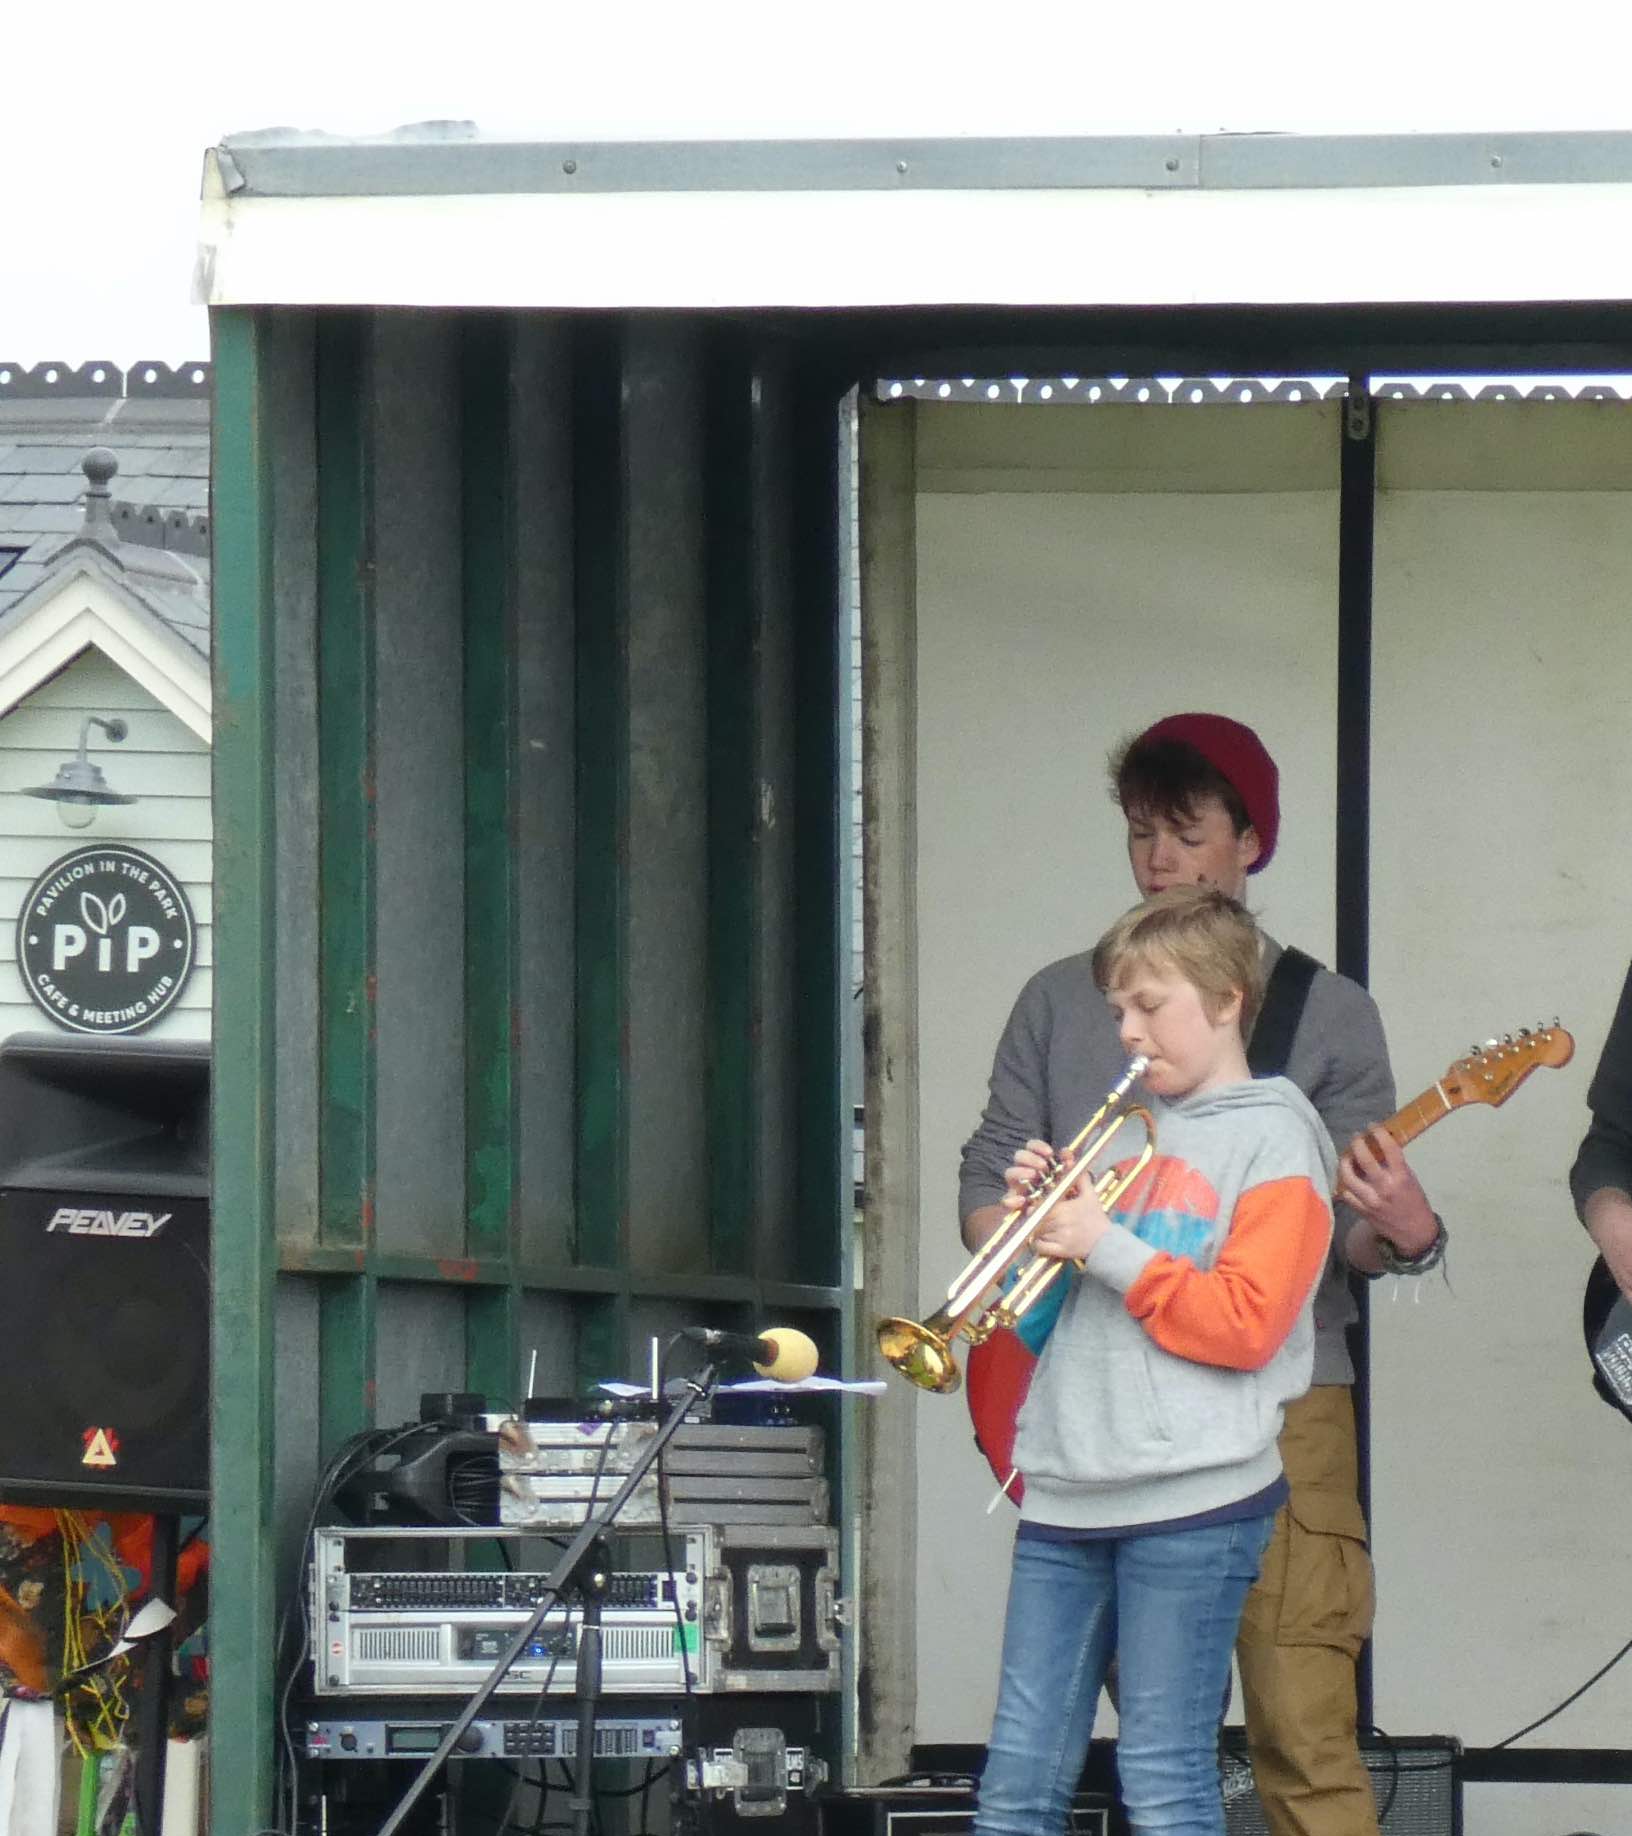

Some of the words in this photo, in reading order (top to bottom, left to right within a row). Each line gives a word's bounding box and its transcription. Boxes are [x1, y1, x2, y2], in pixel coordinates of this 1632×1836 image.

[36, 862, 95, 917] PAVILION
[100, 861, 116, 872] IN
[121, 863, 150, 884] THE
[149, 880, 178, 919] PARK
[37, 974, 69, 1009] CAFE
[68, 1004, 79, 1016] &
[83, 1001, 148, 1024] MEETING
[148, 976, 174, 1004] HUB
[46, 1208, 173, 1237] PEAVEY
